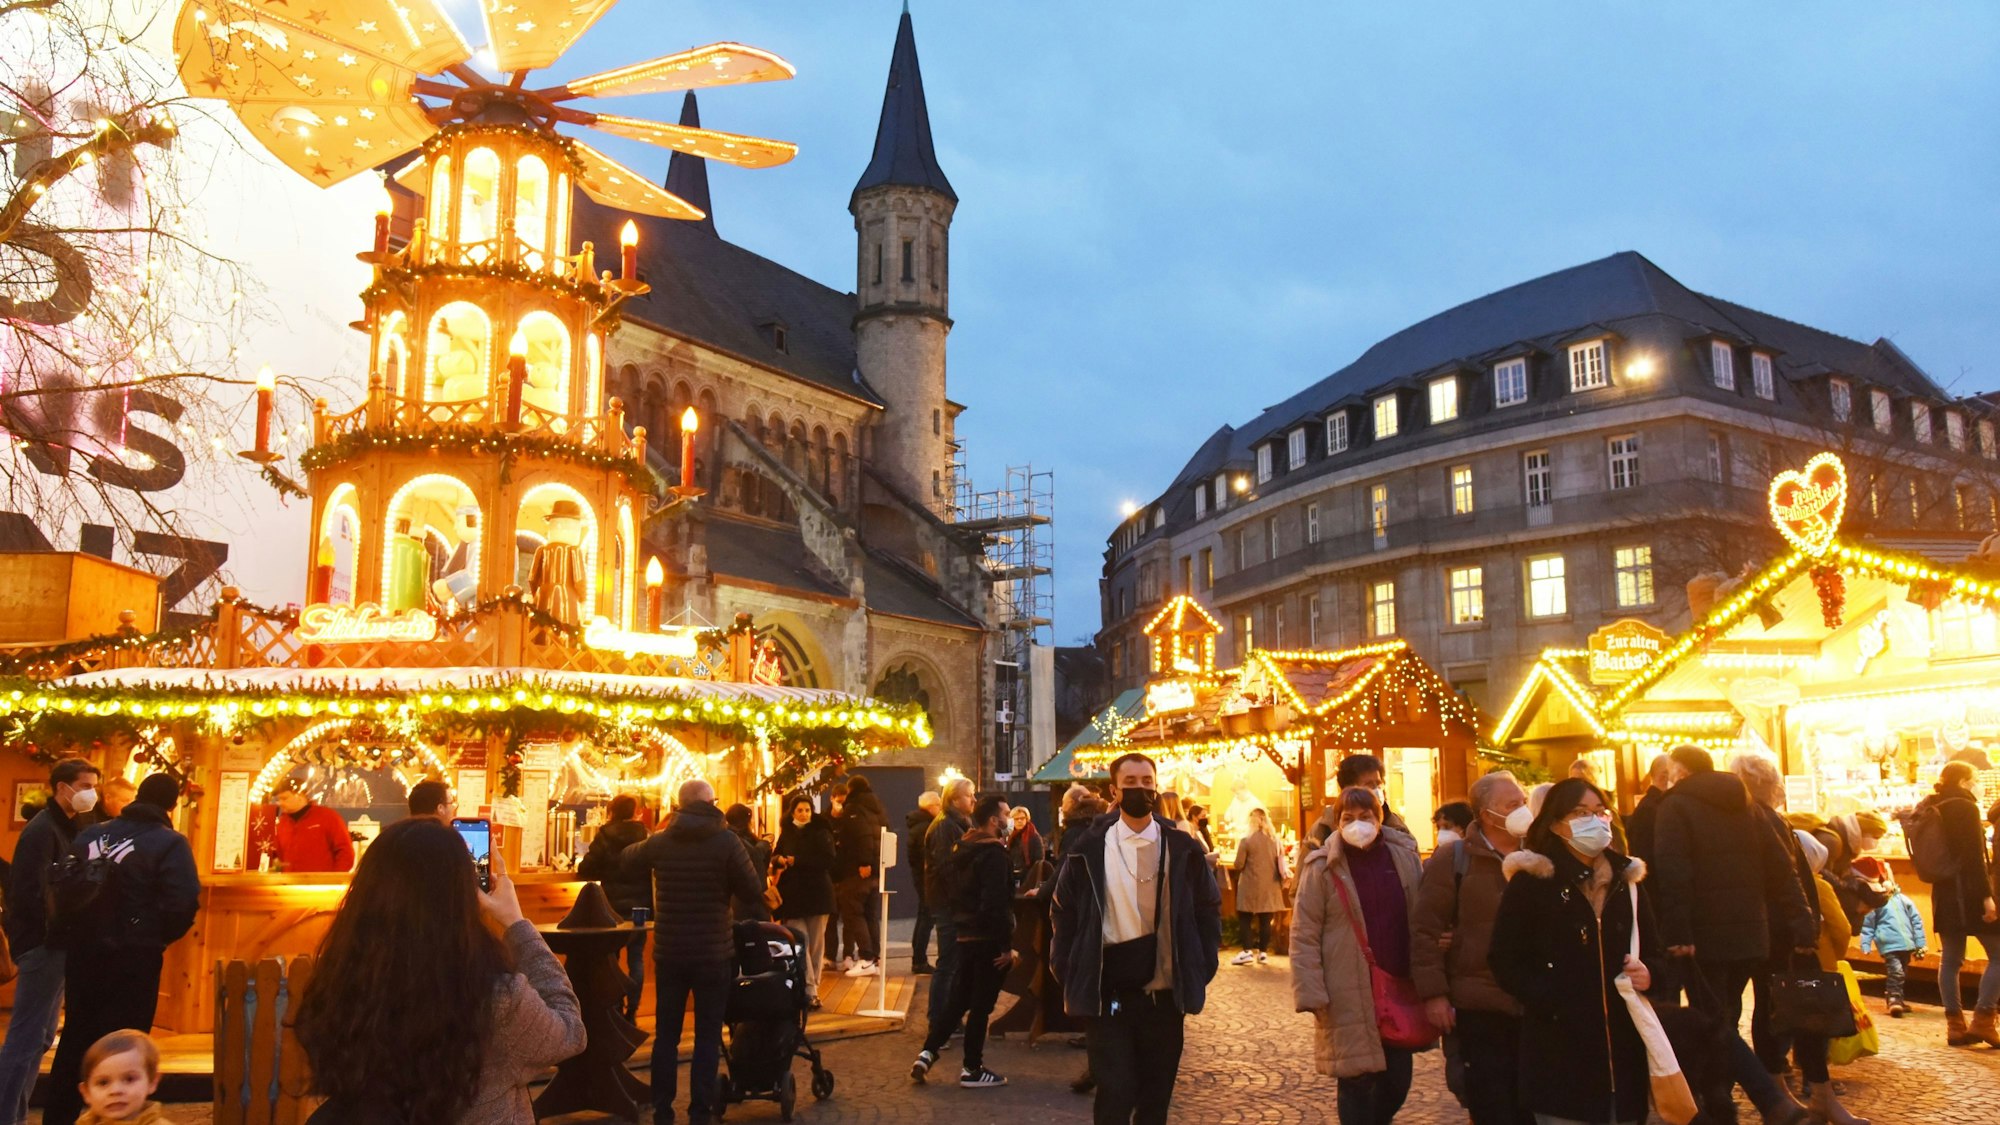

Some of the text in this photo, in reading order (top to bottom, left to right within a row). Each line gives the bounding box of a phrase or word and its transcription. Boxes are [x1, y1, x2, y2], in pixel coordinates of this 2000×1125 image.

[1606, 634, 1660, 652] Zur alten
[1593, 649, 1654, 671] Backst
